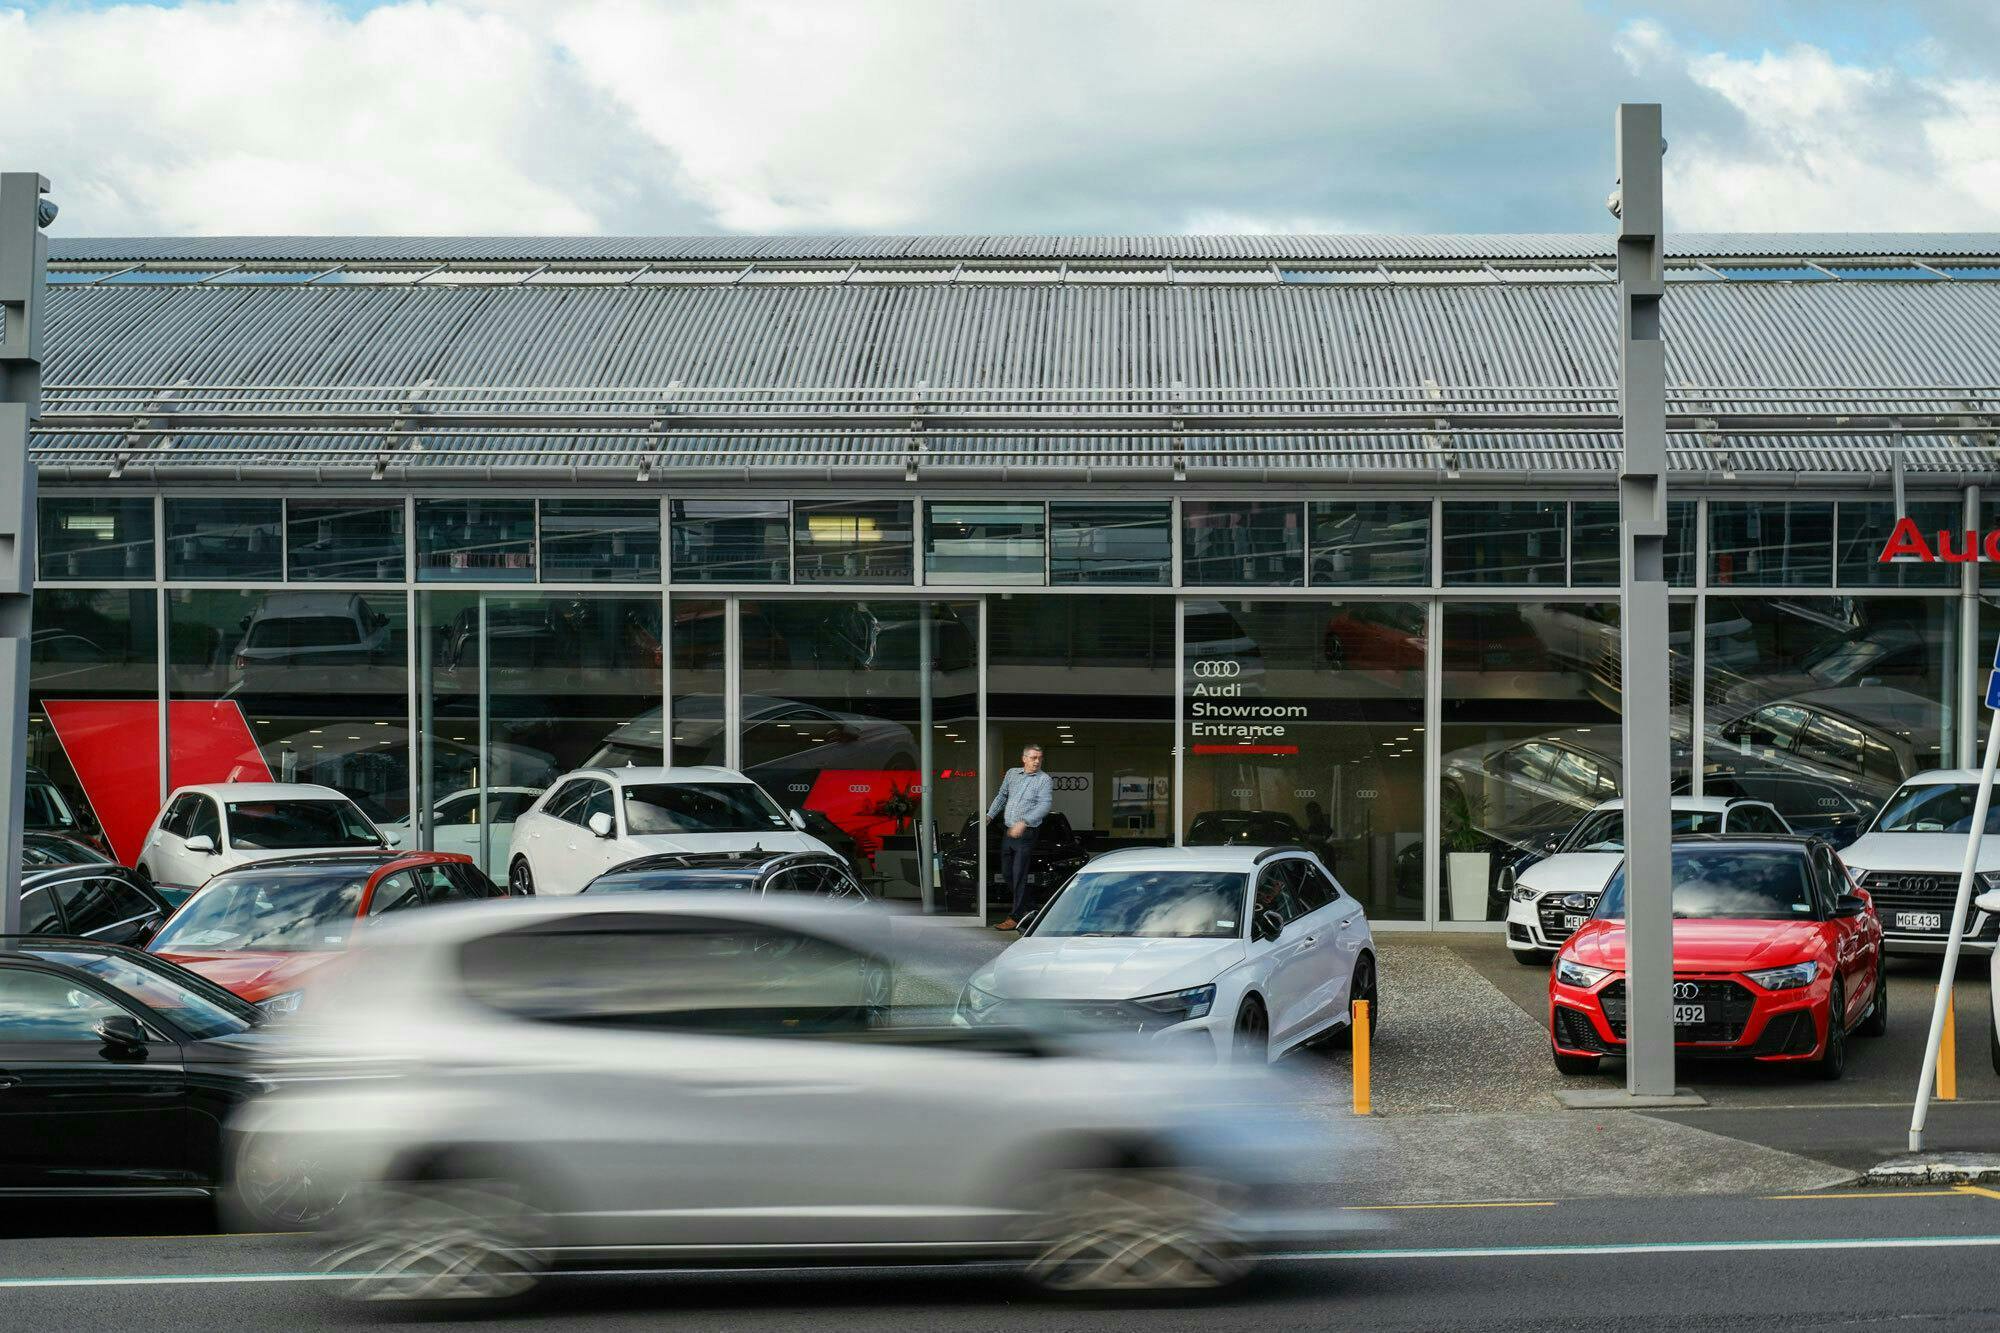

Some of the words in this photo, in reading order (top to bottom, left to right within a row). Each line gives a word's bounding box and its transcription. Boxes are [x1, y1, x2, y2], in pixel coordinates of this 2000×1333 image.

[1192, 683, 1241, 697] Audi
[1192, 702, 1308, 717] Showroom
[1191, 722, 1285, 736] Entrance
[1897, 914, 1939, 927] MGE433
